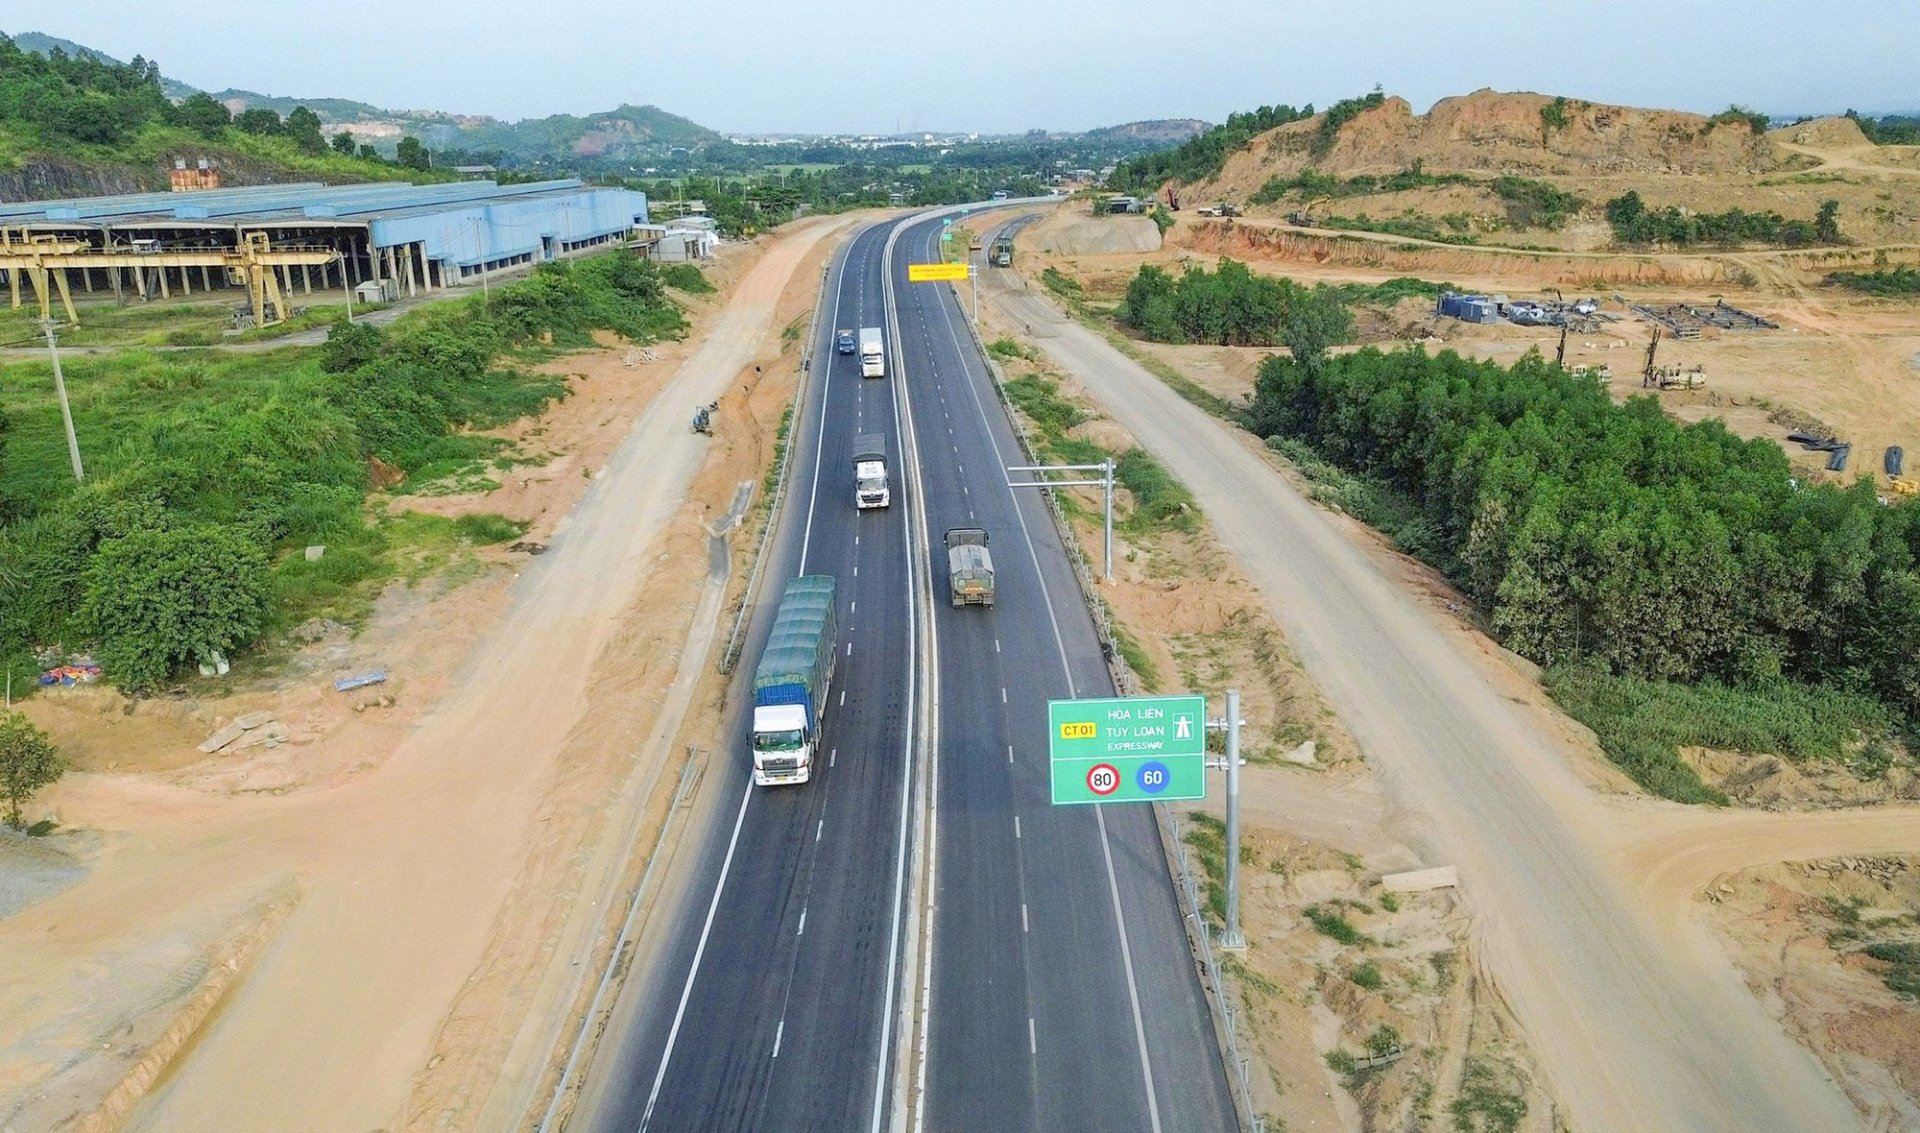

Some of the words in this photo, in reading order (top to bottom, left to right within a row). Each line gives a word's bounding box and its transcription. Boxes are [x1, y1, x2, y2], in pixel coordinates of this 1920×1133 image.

[1107, 707, 1131, 720] HÒA
[1137, 706, 1164, 719] LIÊN
[1063, 725, 1093, 736] CT.01
[1106, 723, 1129, 738] TÚY
[1134, 726, 1165, 737] LOAN
[1107, 741, 1164, 751] EXPRESSWAY
[1093, 773, 1112, 787] 80
[1143, 770, 1163, 785] 60
